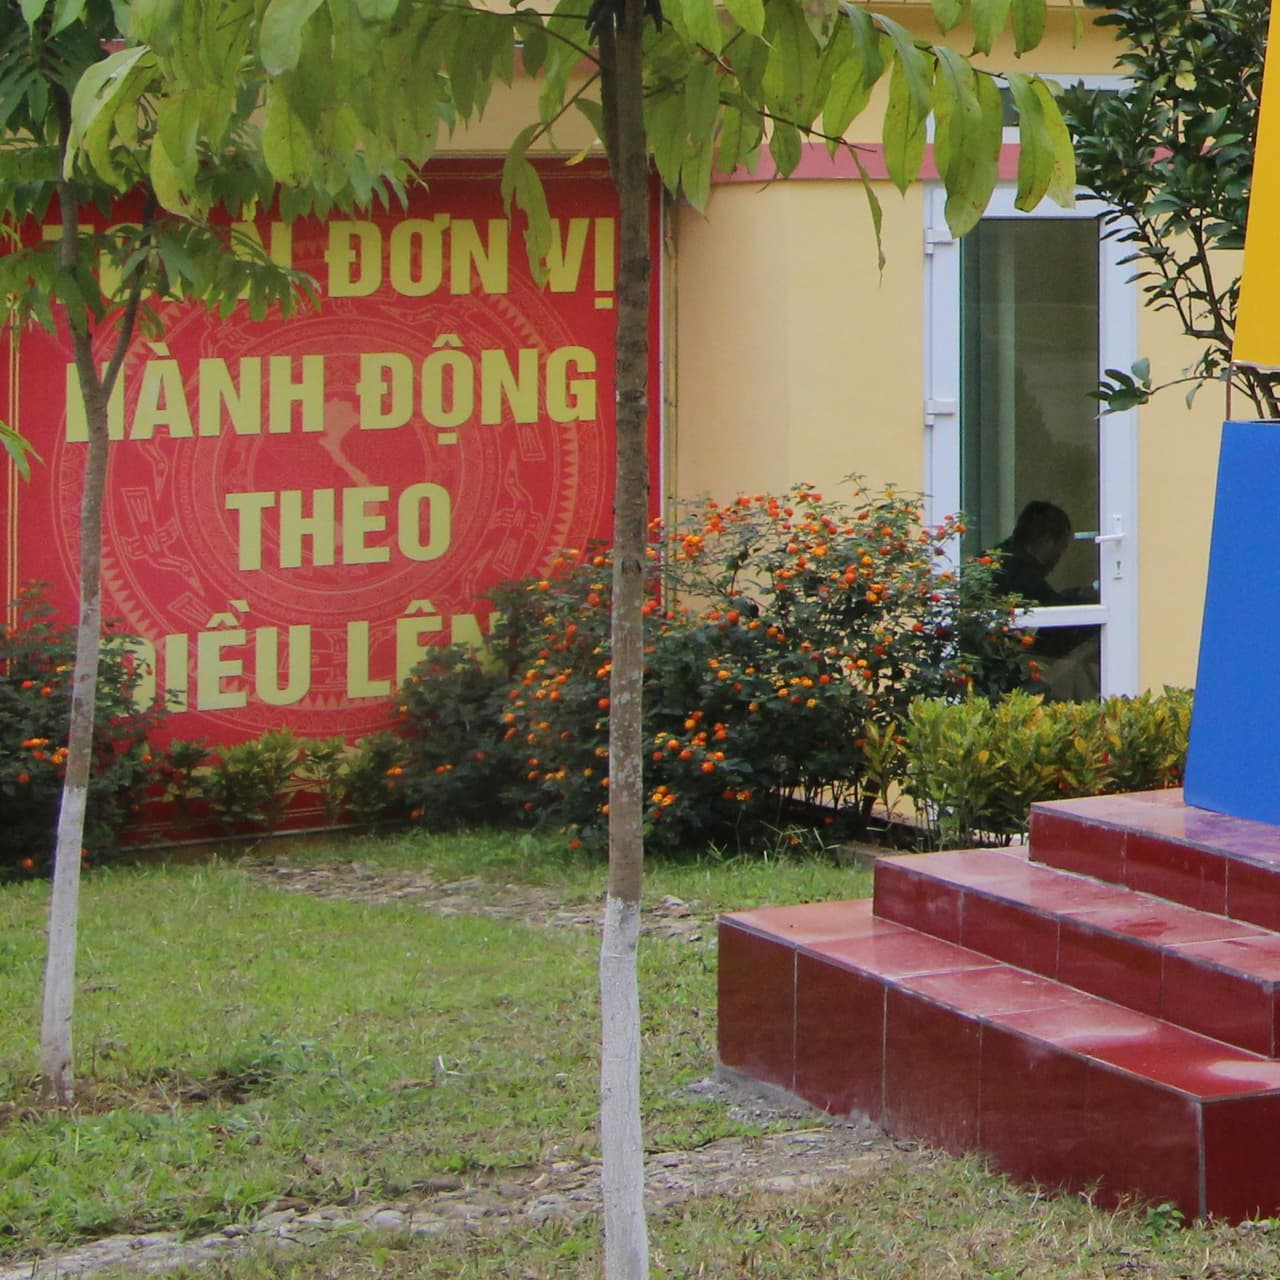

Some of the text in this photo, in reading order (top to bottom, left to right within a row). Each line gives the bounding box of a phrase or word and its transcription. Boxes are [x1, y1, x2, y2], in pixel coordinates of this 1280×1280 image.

[325, 213, 508, 298] ĐƠN
[545, 217, 615, 310] VỊ
[66, 334, 597, 445] HÀNH ĐỘNG
[226, 482, 451, 572] THEO
